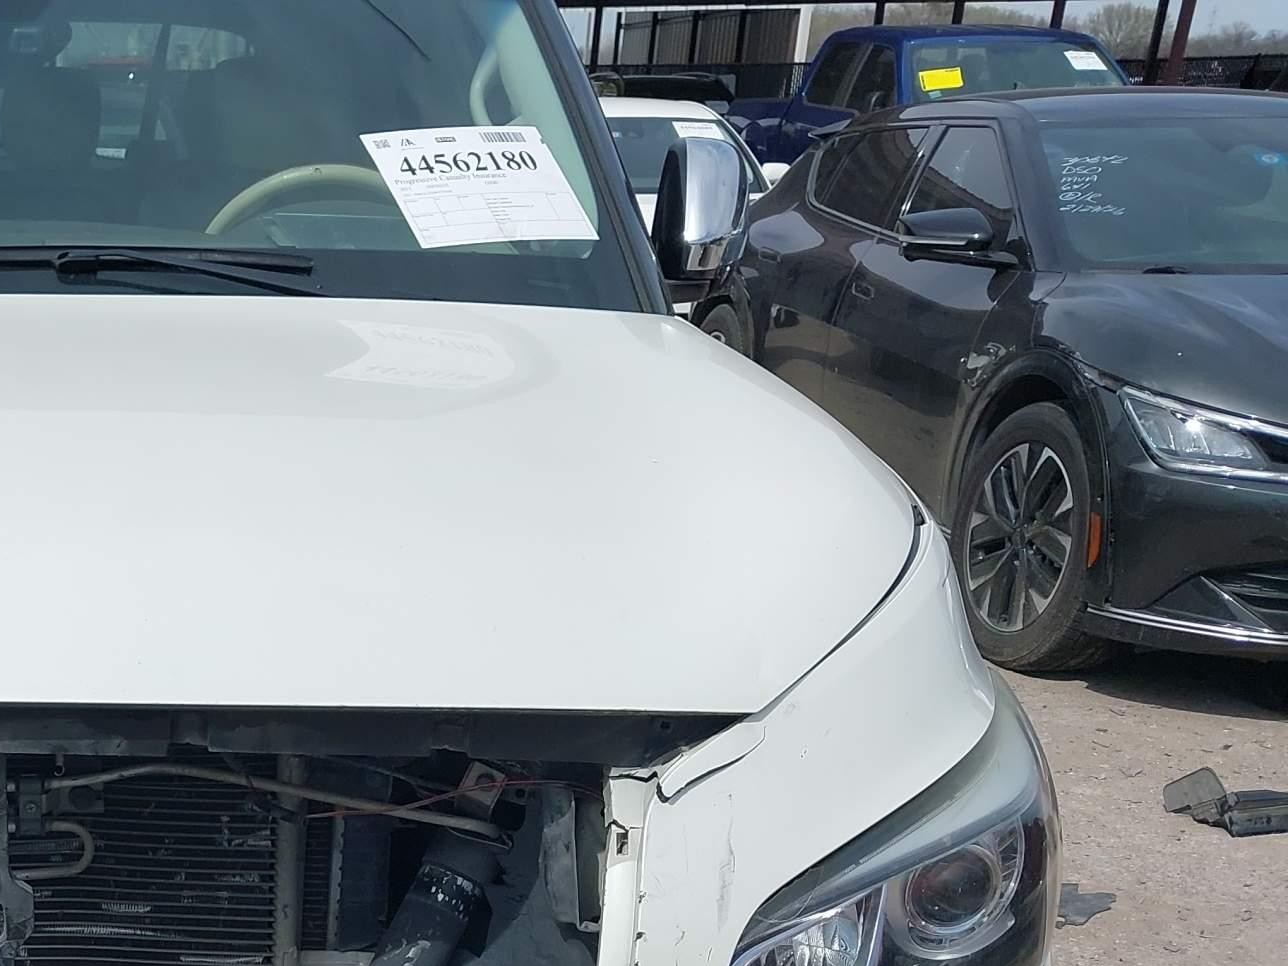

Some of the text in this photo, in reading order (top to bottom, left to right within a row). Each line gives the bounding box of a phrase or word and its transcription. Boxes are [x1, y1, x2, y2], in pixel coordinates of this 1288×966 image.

[400, 150, 538, 176] 44562180
[394, 175, 438, 186] Progressive
[438, 173, 471, 182] Casualty
[472, 172, 508, 180] Insurance
